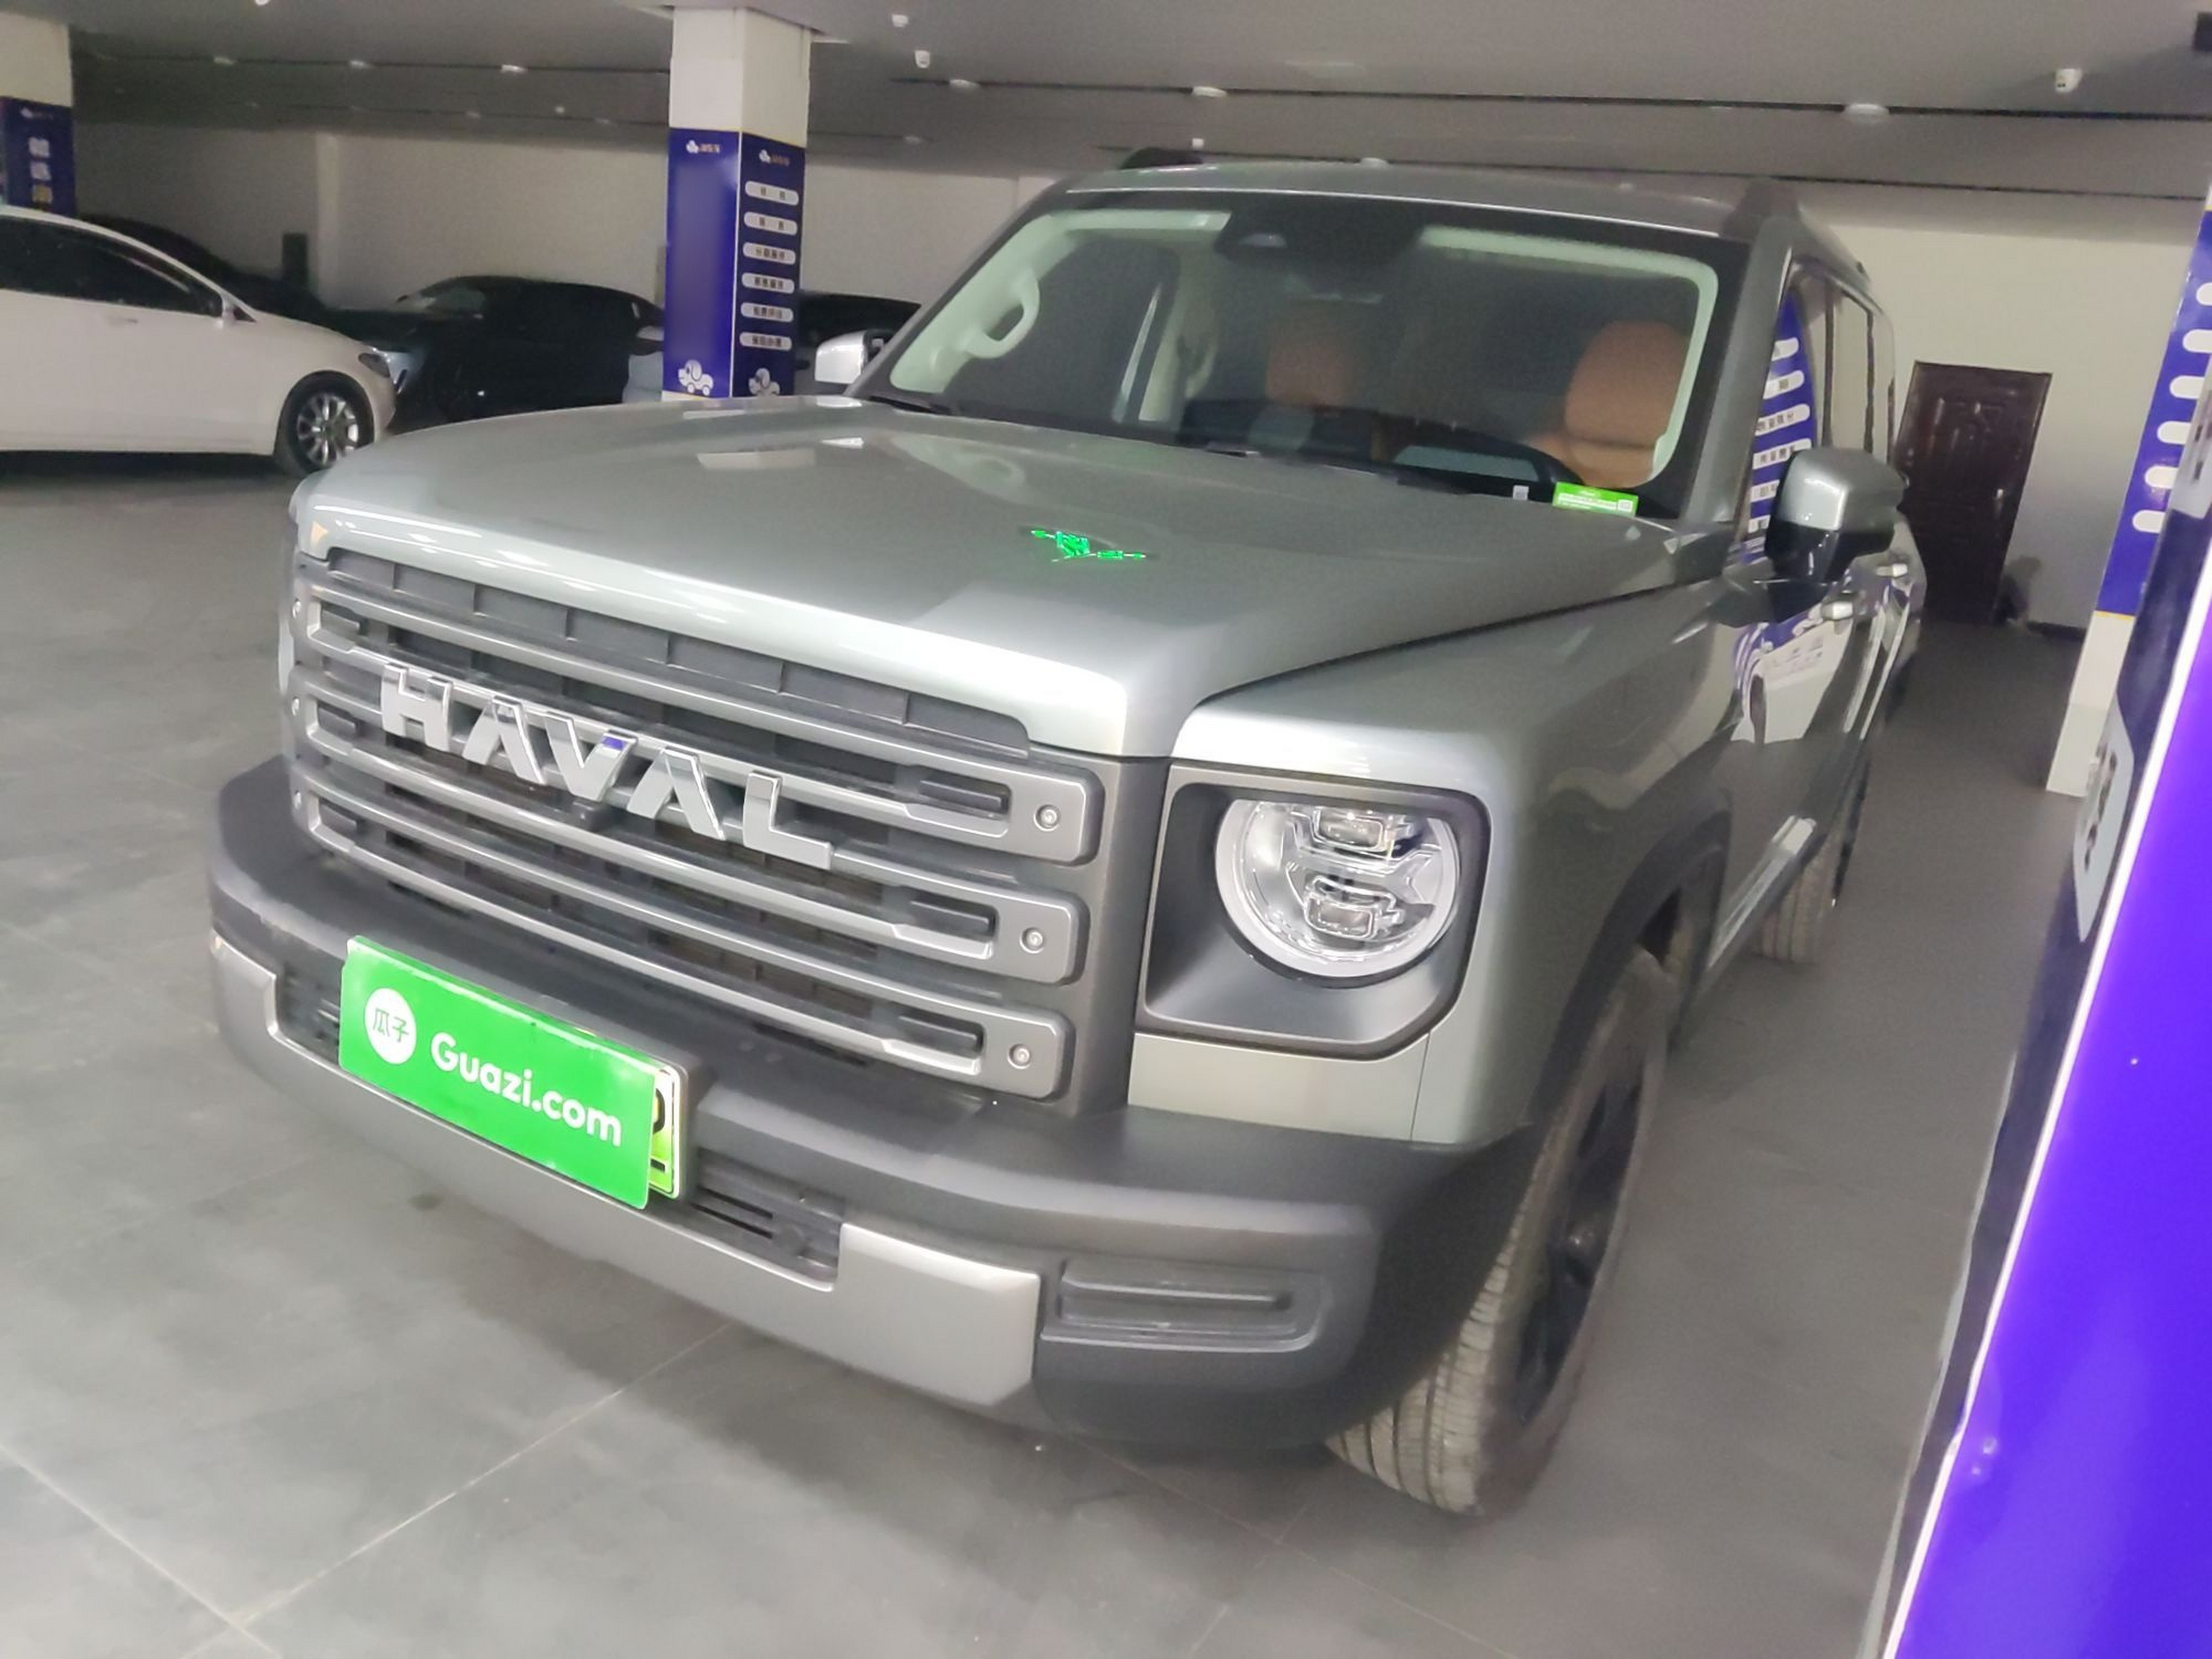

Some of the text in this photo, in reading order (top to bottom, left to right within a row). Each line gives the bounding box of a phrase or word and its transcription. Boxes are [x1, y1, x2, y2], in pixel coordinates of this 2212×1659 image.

[382, 662, 832, 870] HAVAL
[372, 1008, 410, 1043] 瓜子
[430, 1032, 622, 1146] Guazi.com
